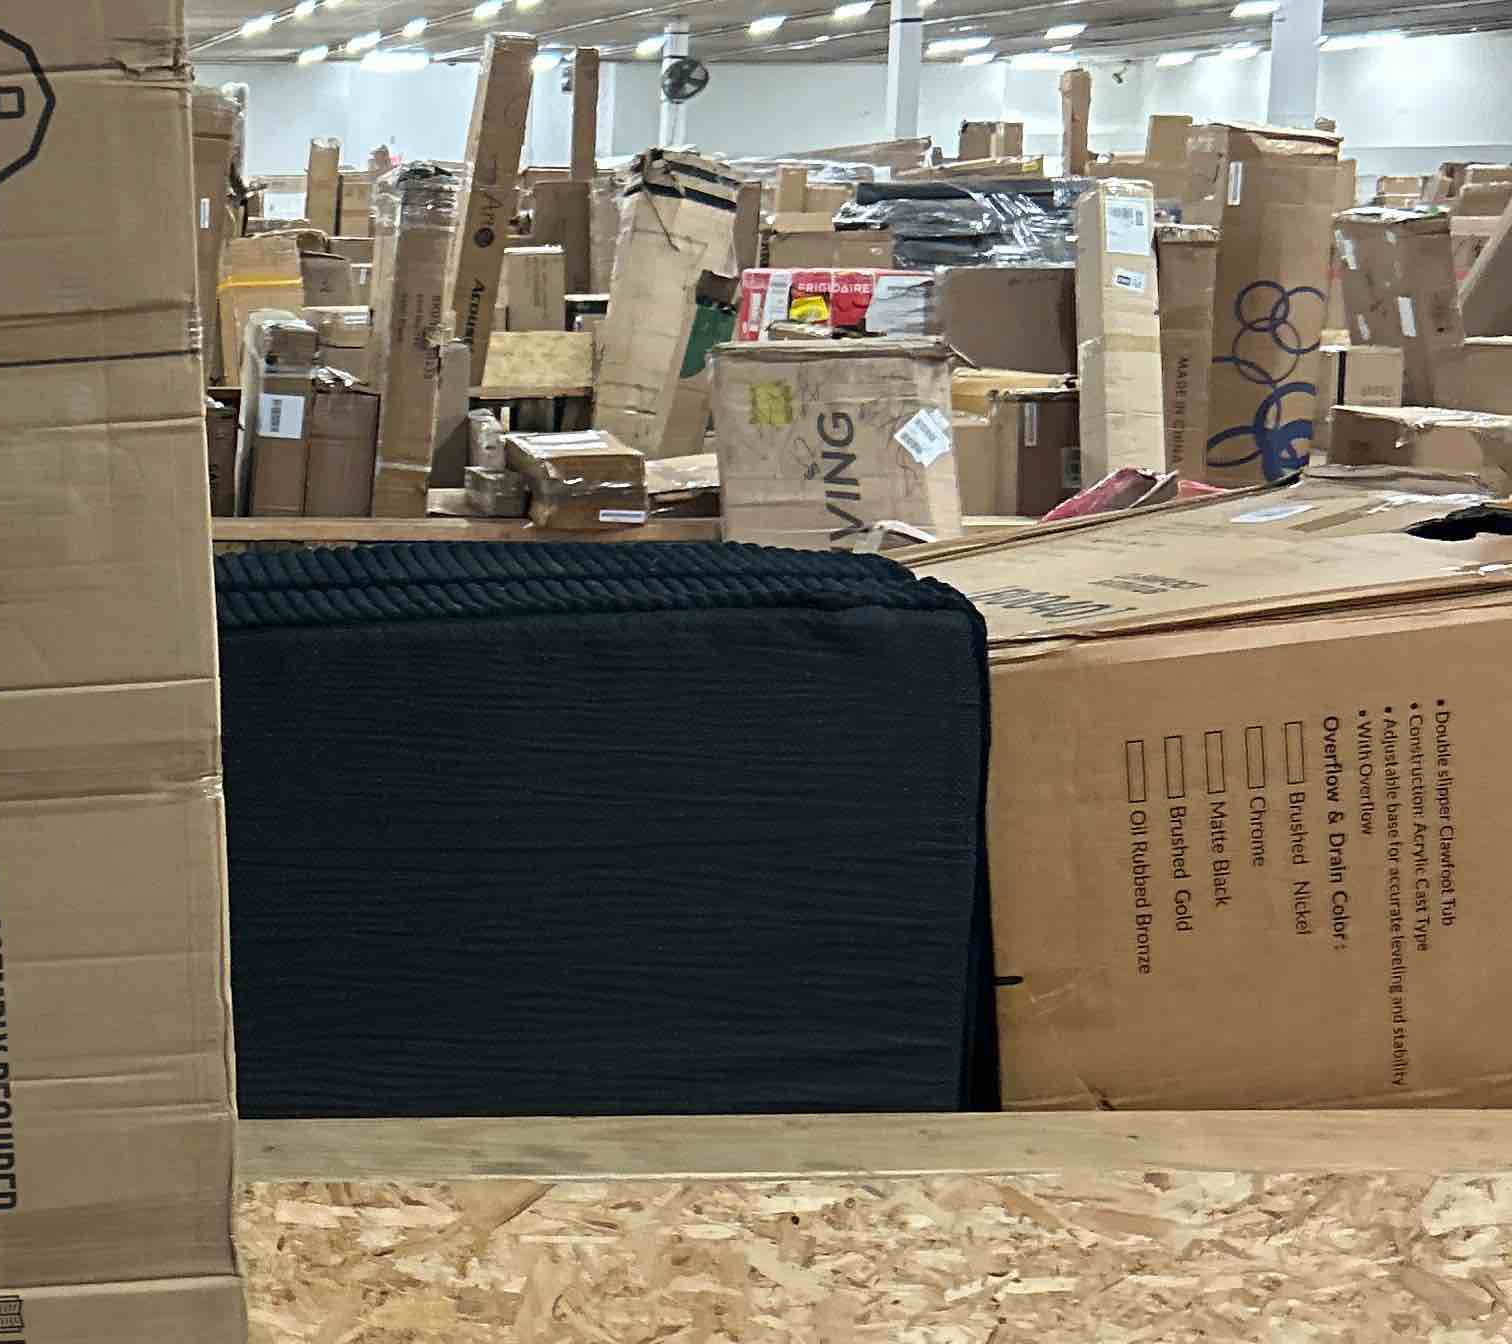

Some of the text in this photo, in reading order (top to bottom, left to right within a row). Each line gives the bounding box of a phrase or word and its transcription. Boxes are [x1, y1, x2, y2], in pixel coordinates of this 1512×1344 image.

[797, 281, 873, 294] FRIGIDAIRE
[816, 412, 864, 546] VING
[1323, 716, 1343, 802] Overflow
[1357, 721, 1375, 835] With Overflow
[1209, 801, 1232, 907] Matte Black
[1250, 797, 1267, 867] Chrome
[1289, 792, 1313, 935] Brushed Nickel
[1328, 811, 1344, 824] &
[1328, 833, 1346, 883] Drain
[1412, 823, 1429, 877] Acrylic
[1435, 711, 1457, 927] Double slipper Clawfoot Tub
[1129, 810, 1152, 975] Oil Rubbed Bronze
[1169, 806, 1193, 932] Brushed Gold
[1382, 718, 1409, 1086] Adjustable base for accurate leveling and stability
[1416, 878, 1430, 912] Cast
[1413, 916, 1431, 951] Type
